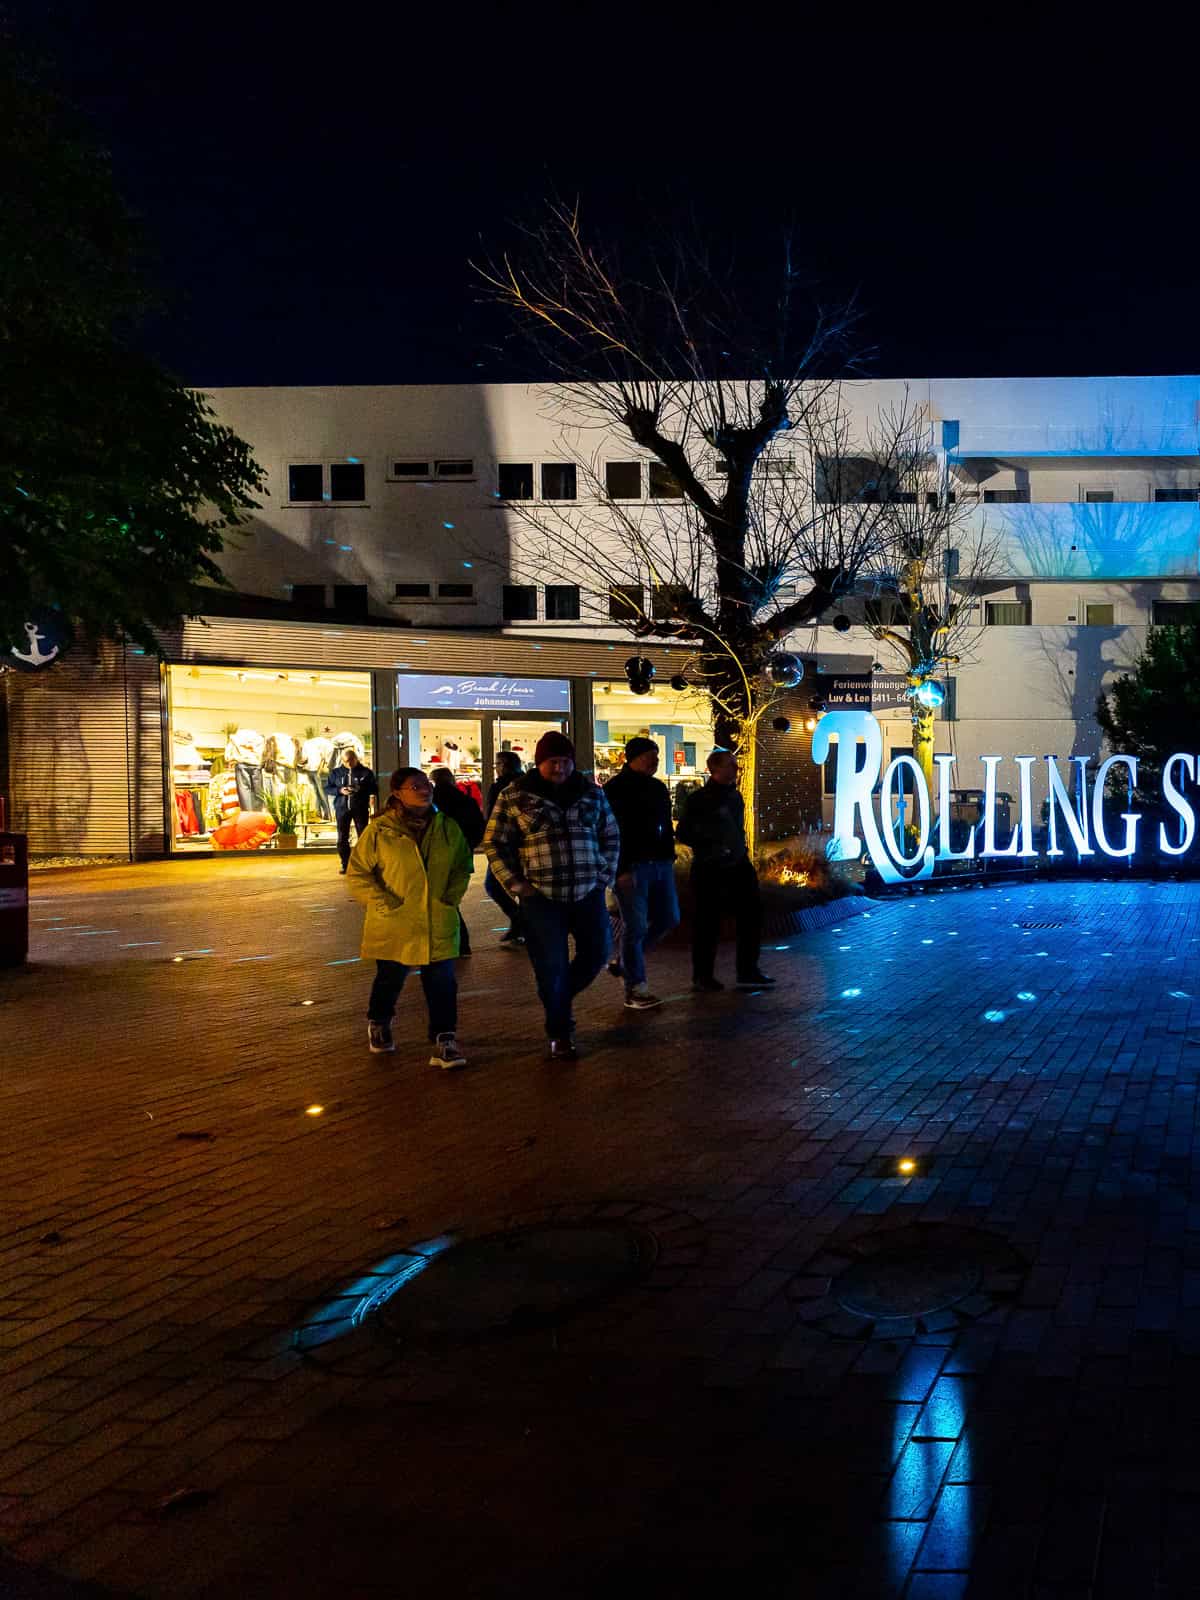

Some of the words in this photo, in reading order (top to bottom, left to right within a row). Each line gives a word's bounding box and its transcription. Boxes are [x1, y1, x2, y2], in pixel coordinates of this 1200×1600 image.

[457, 680, 500, 695] Beach
[828, 693, 844, 703] Luv
[845, 693, 853, 703] &
[811, 710, 1142, 884] ROLLING
